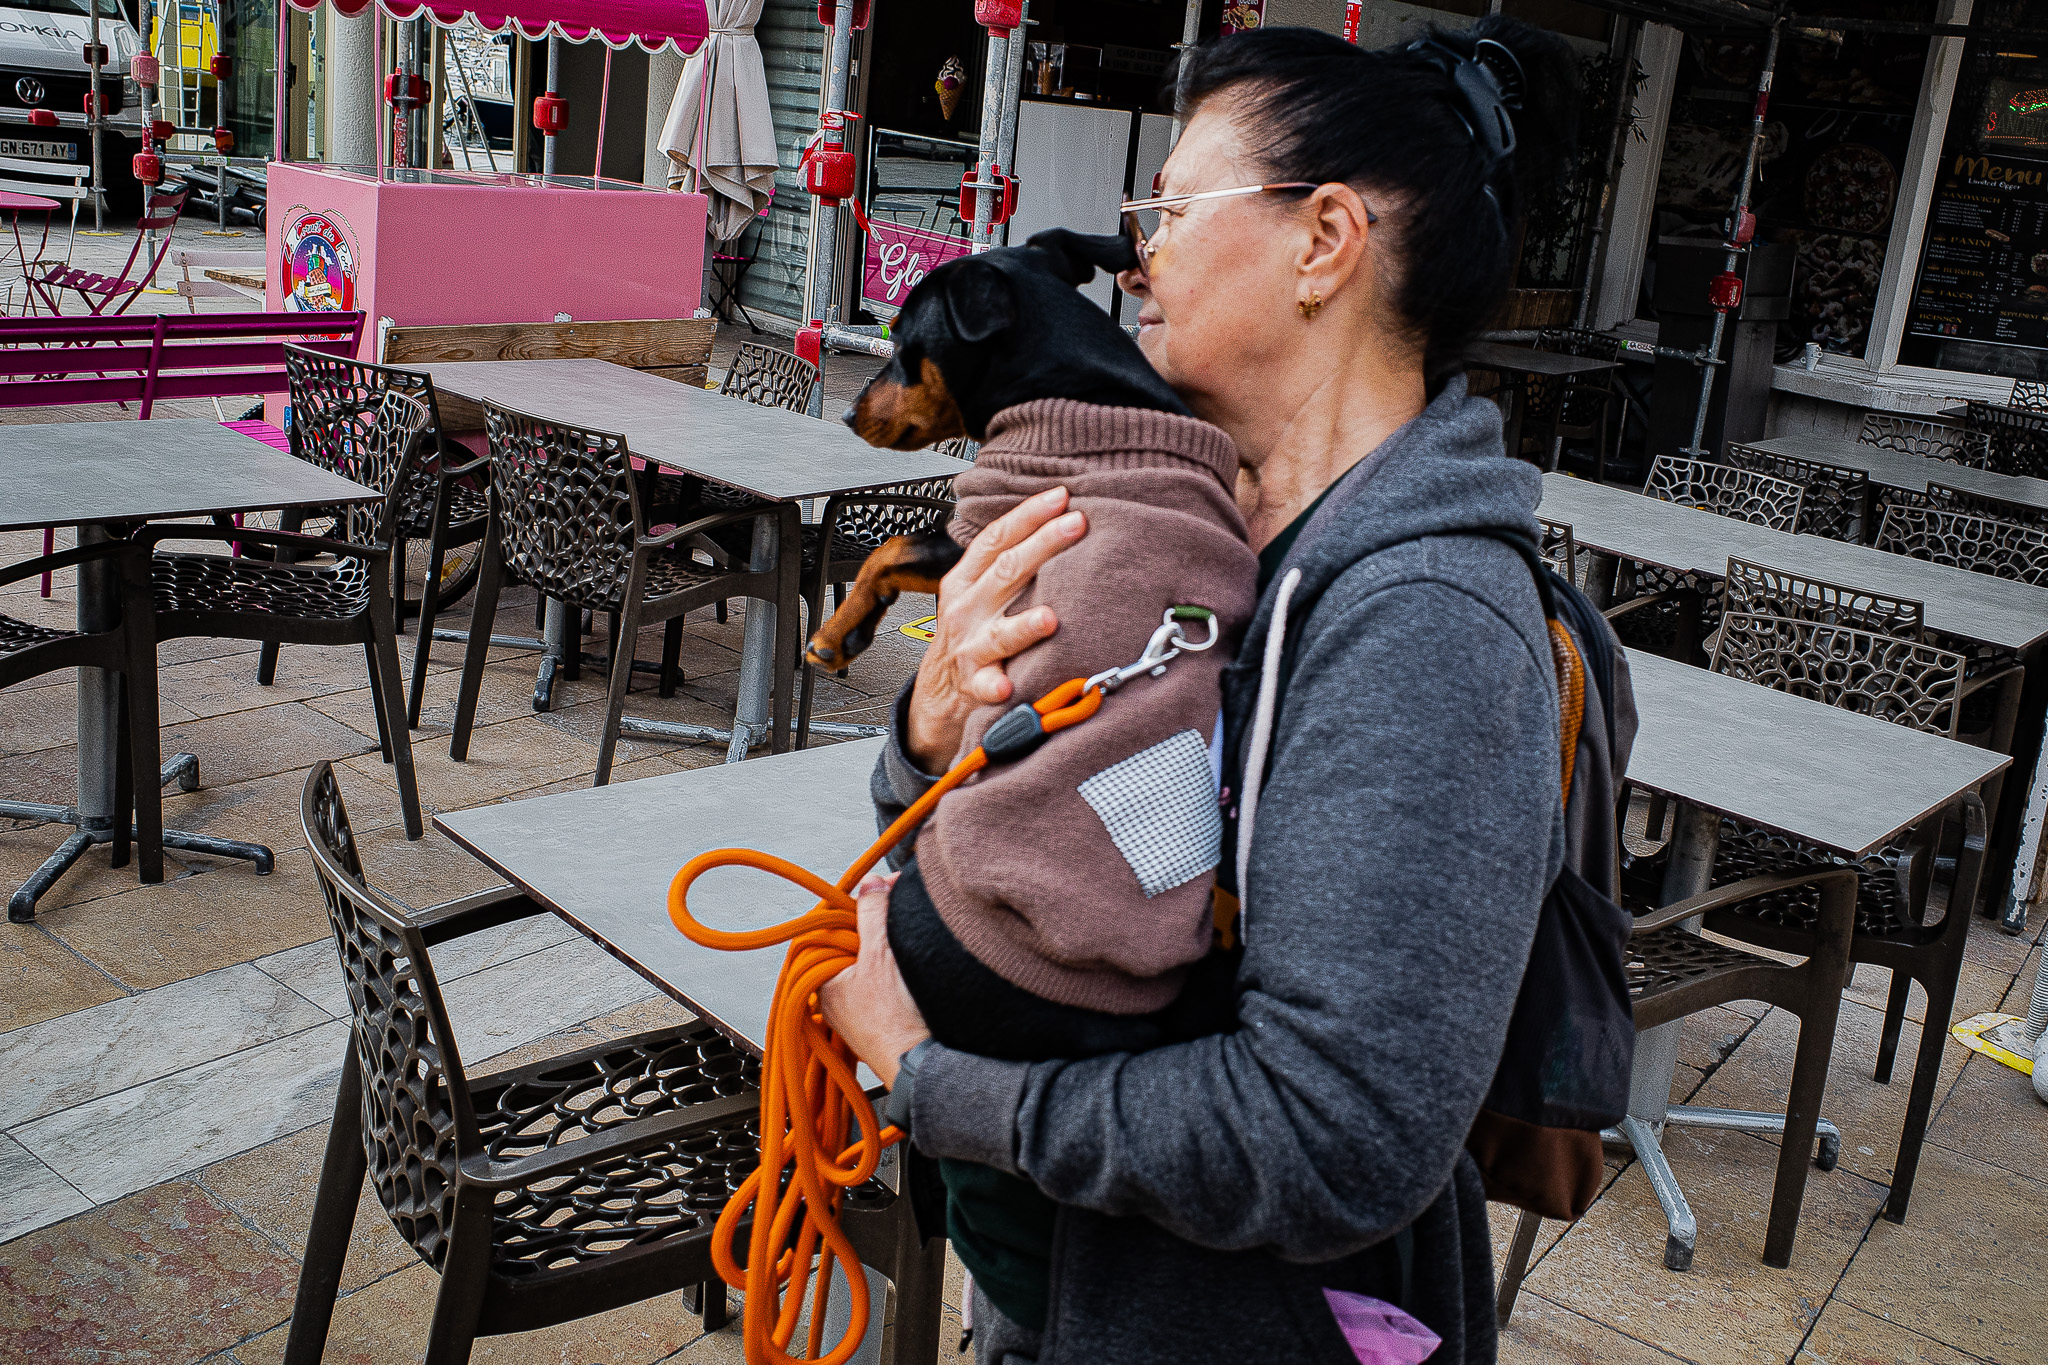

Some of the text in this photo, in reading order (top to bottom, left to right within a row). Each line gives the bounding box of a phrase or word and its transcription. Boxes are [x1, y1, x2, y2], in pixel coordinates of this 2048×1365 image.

[0, 141, 67, 157] GN-671-AY
[1954, 153, 2042, 186] Menu
[1941, 192, 2001, 204] SANDWICH
[1951, 237, 1991, 248] PANINI
[1943, 267, 1985, 277] BURGERS
[1939, 290, 1973, 300] TACOS
[1919, 313, 1962, 324] BOISSON
